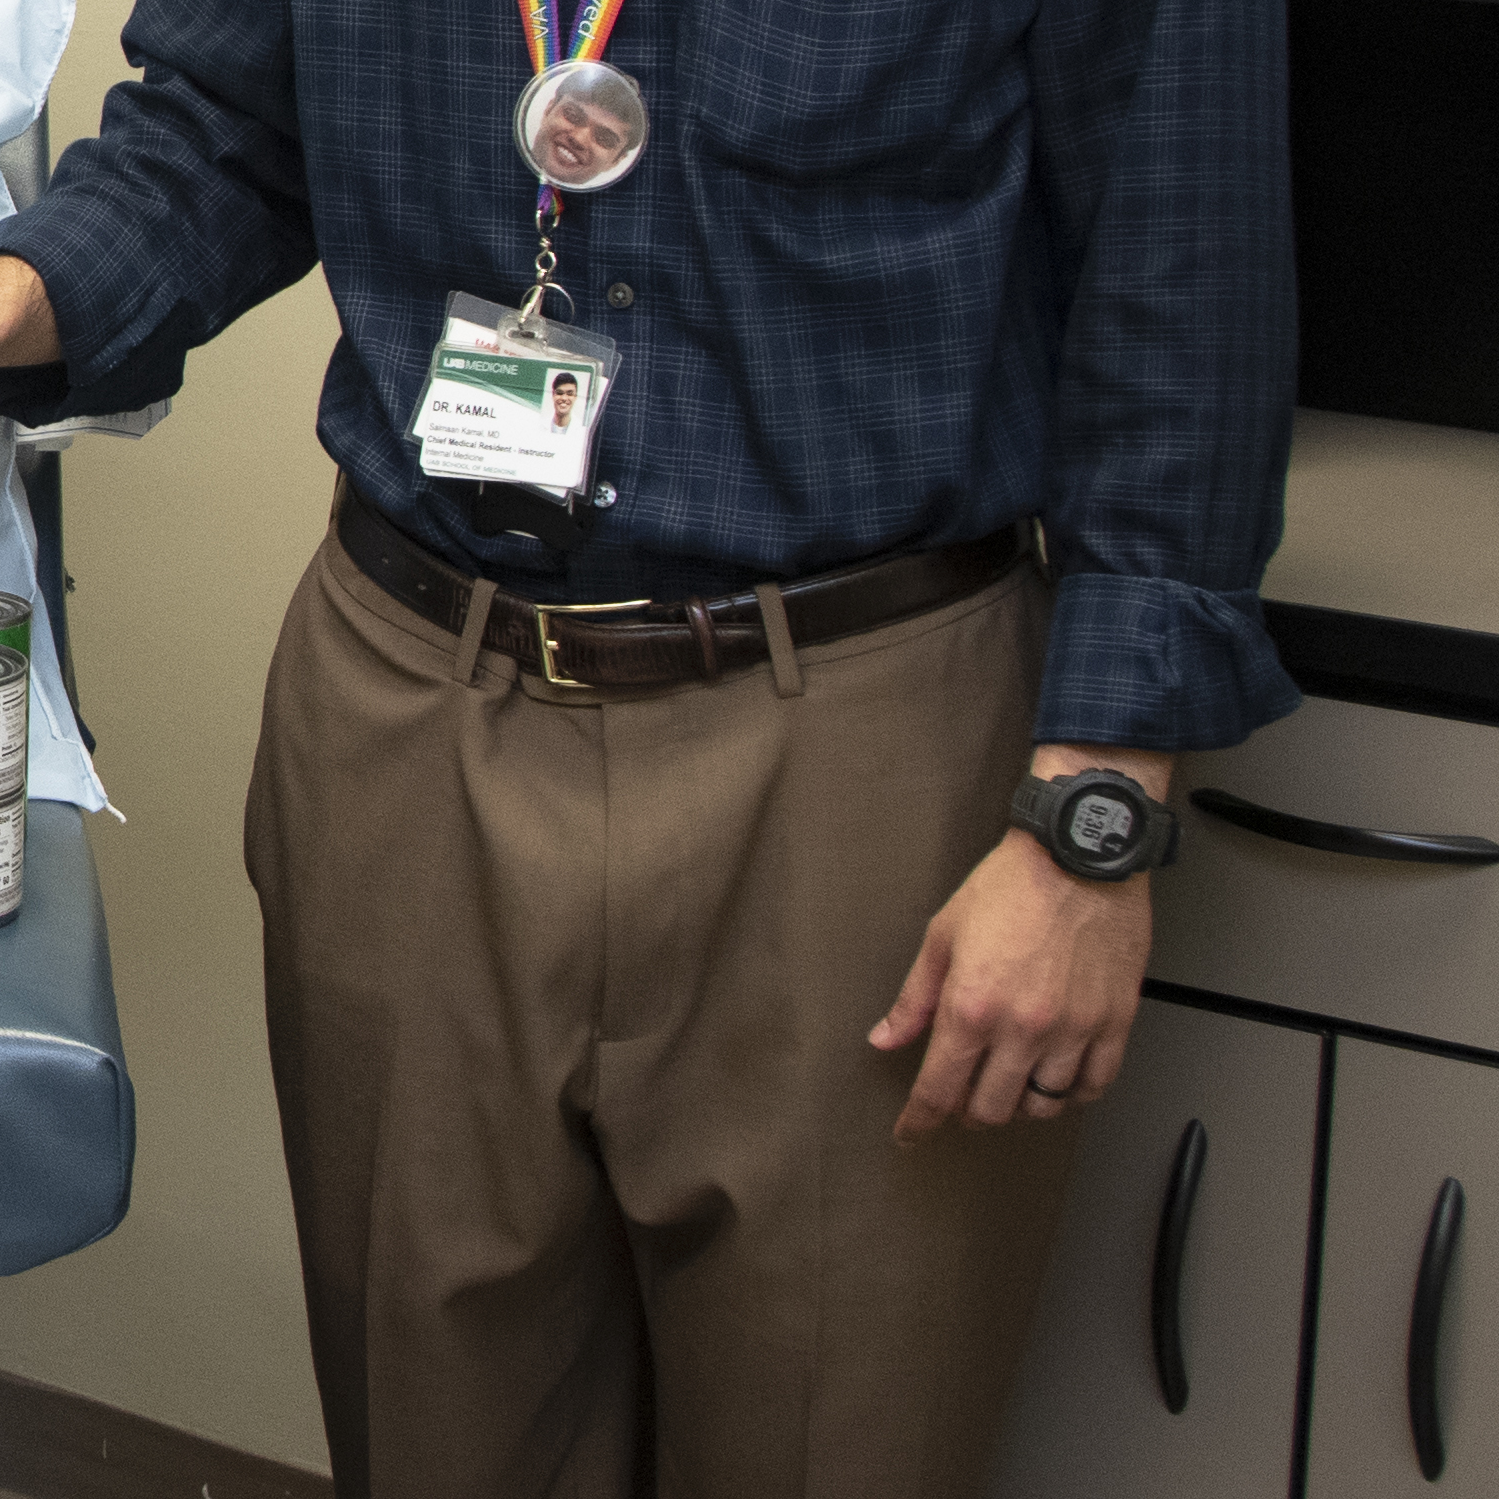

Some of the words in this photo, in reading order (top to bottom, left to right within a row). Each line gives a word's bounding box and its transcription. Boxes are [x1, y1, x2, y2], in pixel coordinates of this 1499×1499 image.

[530, 5, 550, 40] VA
[465, 359, 519, 376] MEDICINE
[432, 401, 452, 414] DR.
[455, 403, 497, 419] KAMAL
[427, 435, 447, 445] Chief
[449, 438, 477, 449] Medical
[479, 442, 512, 453] Resident
